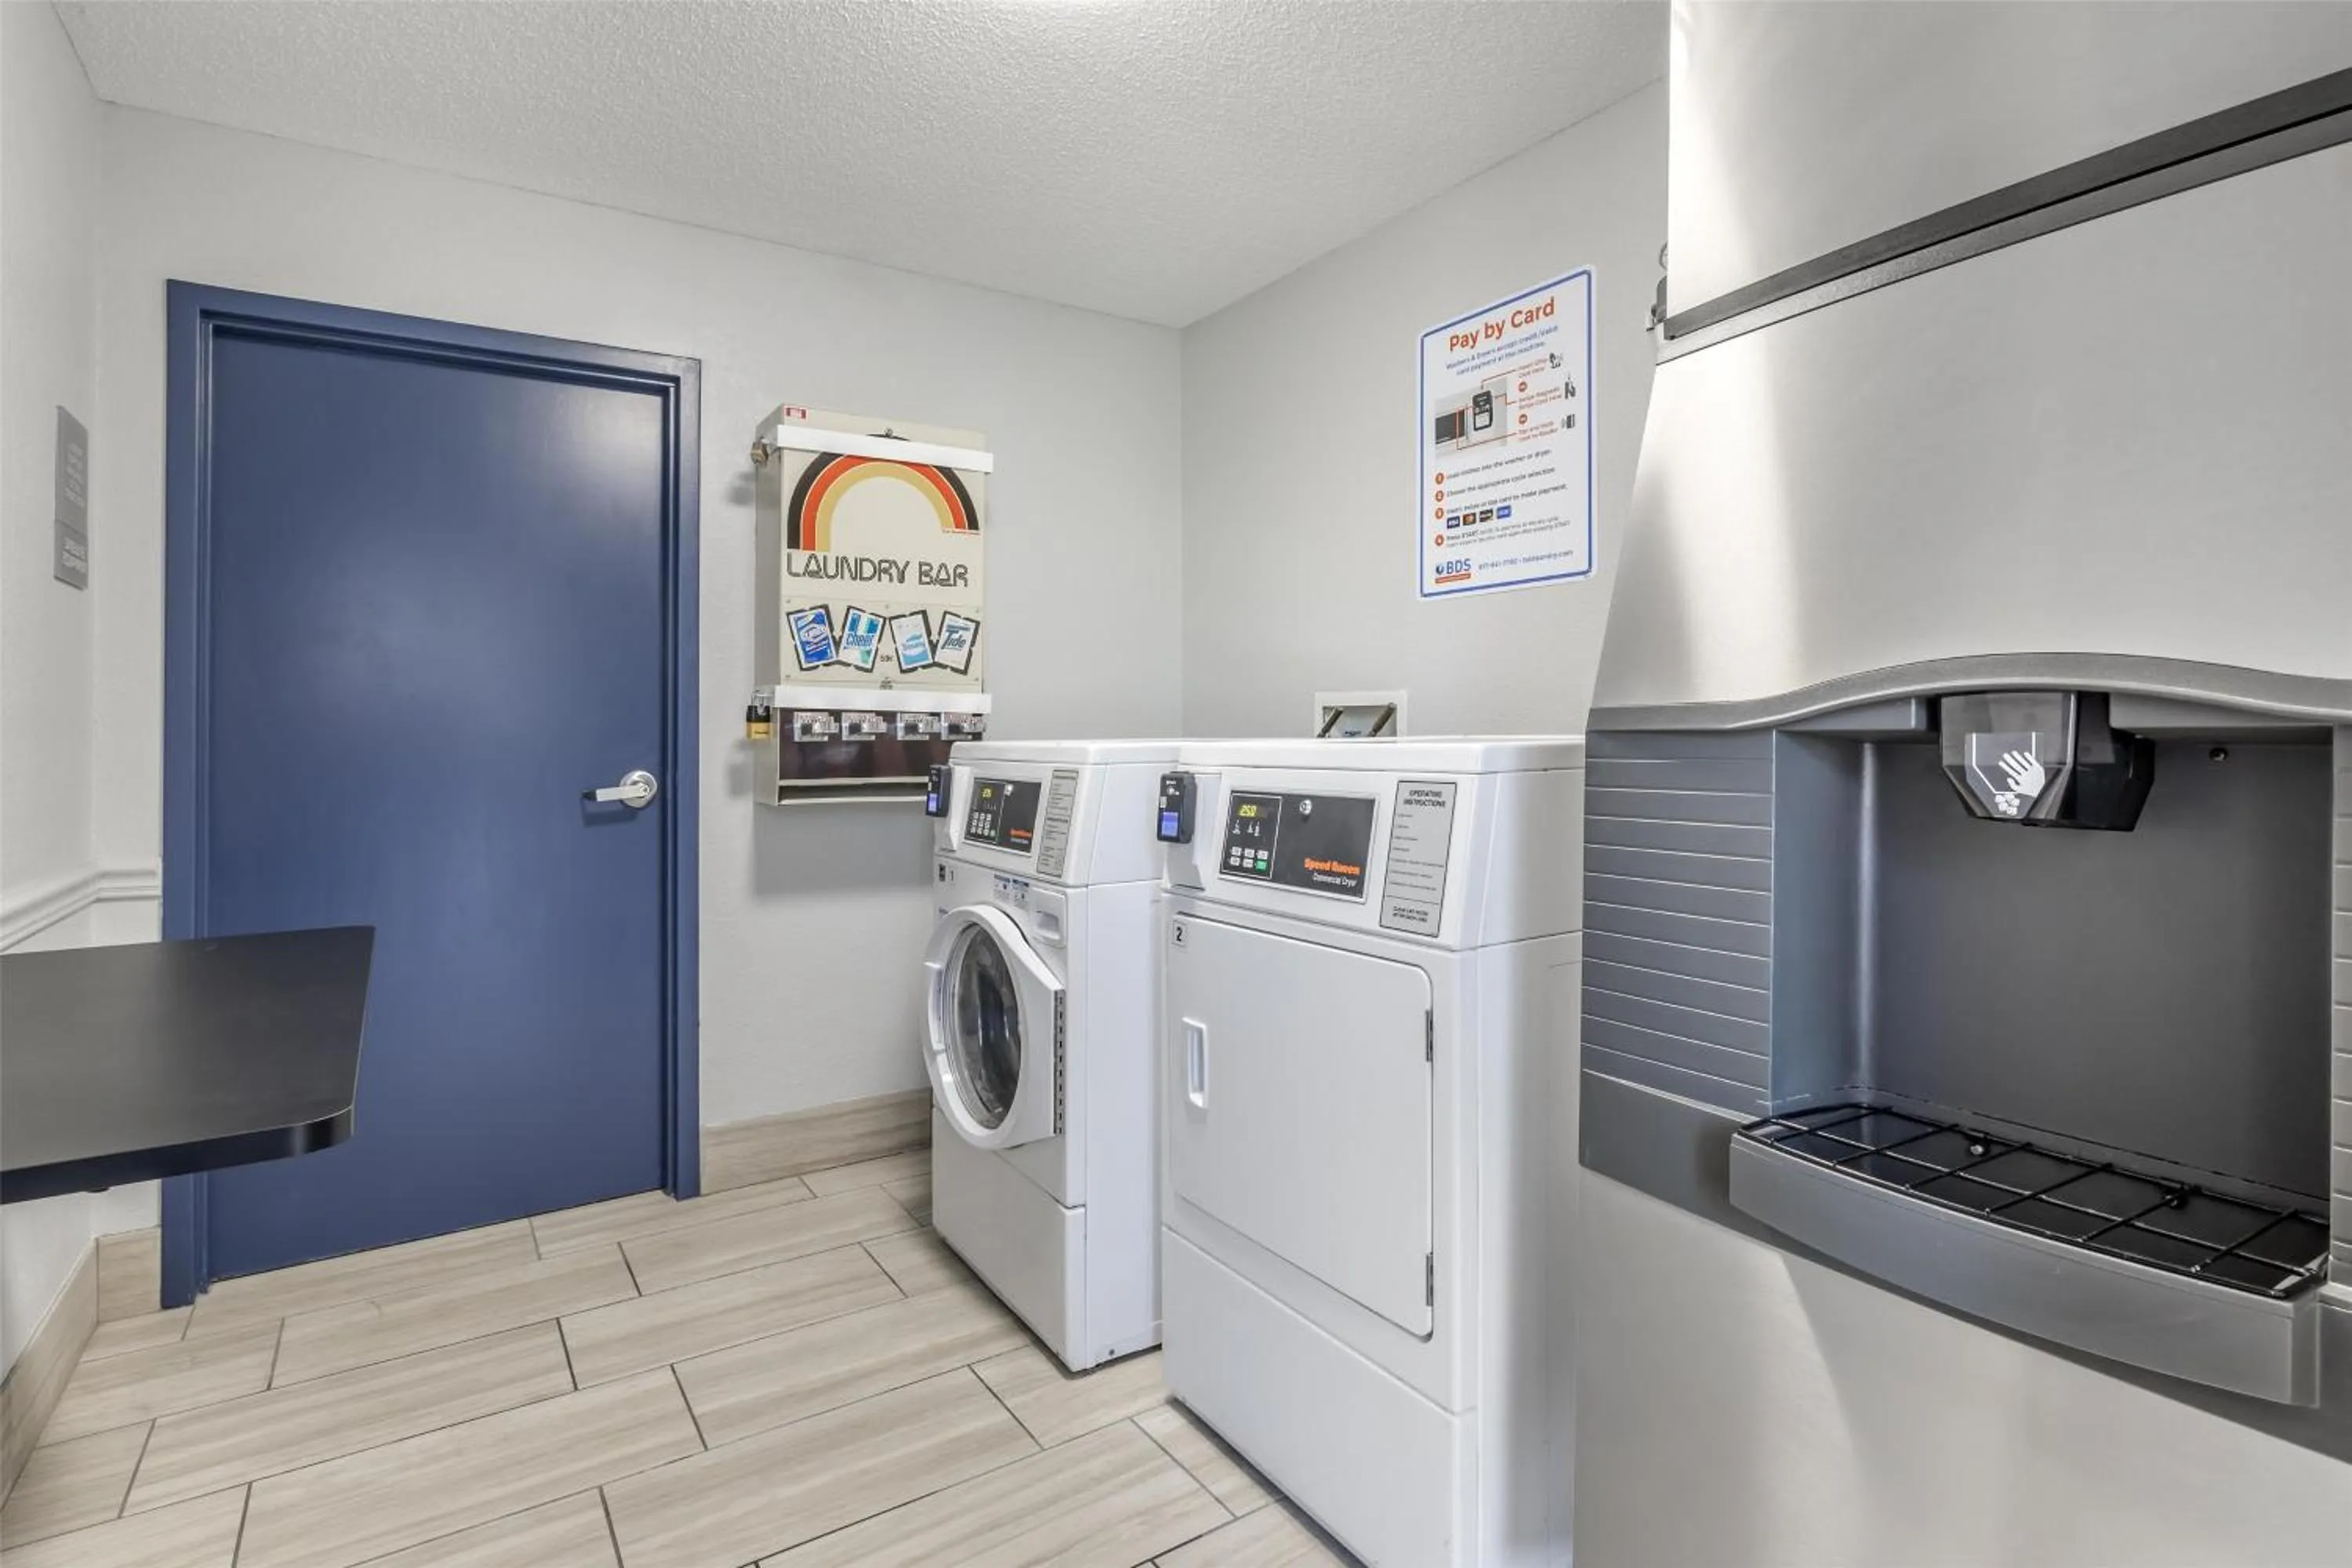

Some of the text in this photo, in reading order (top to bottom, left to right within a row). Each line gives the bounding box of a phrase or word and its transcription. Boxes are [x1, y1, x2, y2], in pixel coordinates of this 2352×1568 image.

[1450, 329, 1480, 351] Pay
[1484, 319, 1505, 339] by
[1511, 296, 1555, 328] Card
[786, 551, 968, 587] LAUNDRY BAR
[1446, 558, 1472, 575] BDS
[846, 632, 874, 647] Cheer
[942, 630, 967, 649] Tide
[1409, 789, 1443, 798] OPERATING
[1403, 799, 1446, 808] INSTRUCTIONS
[1304, 857, 1360, 876] Speed Queen
[1341, 876, 1358, 888] Dryer
[1176, 926, 1183, 942] 2
